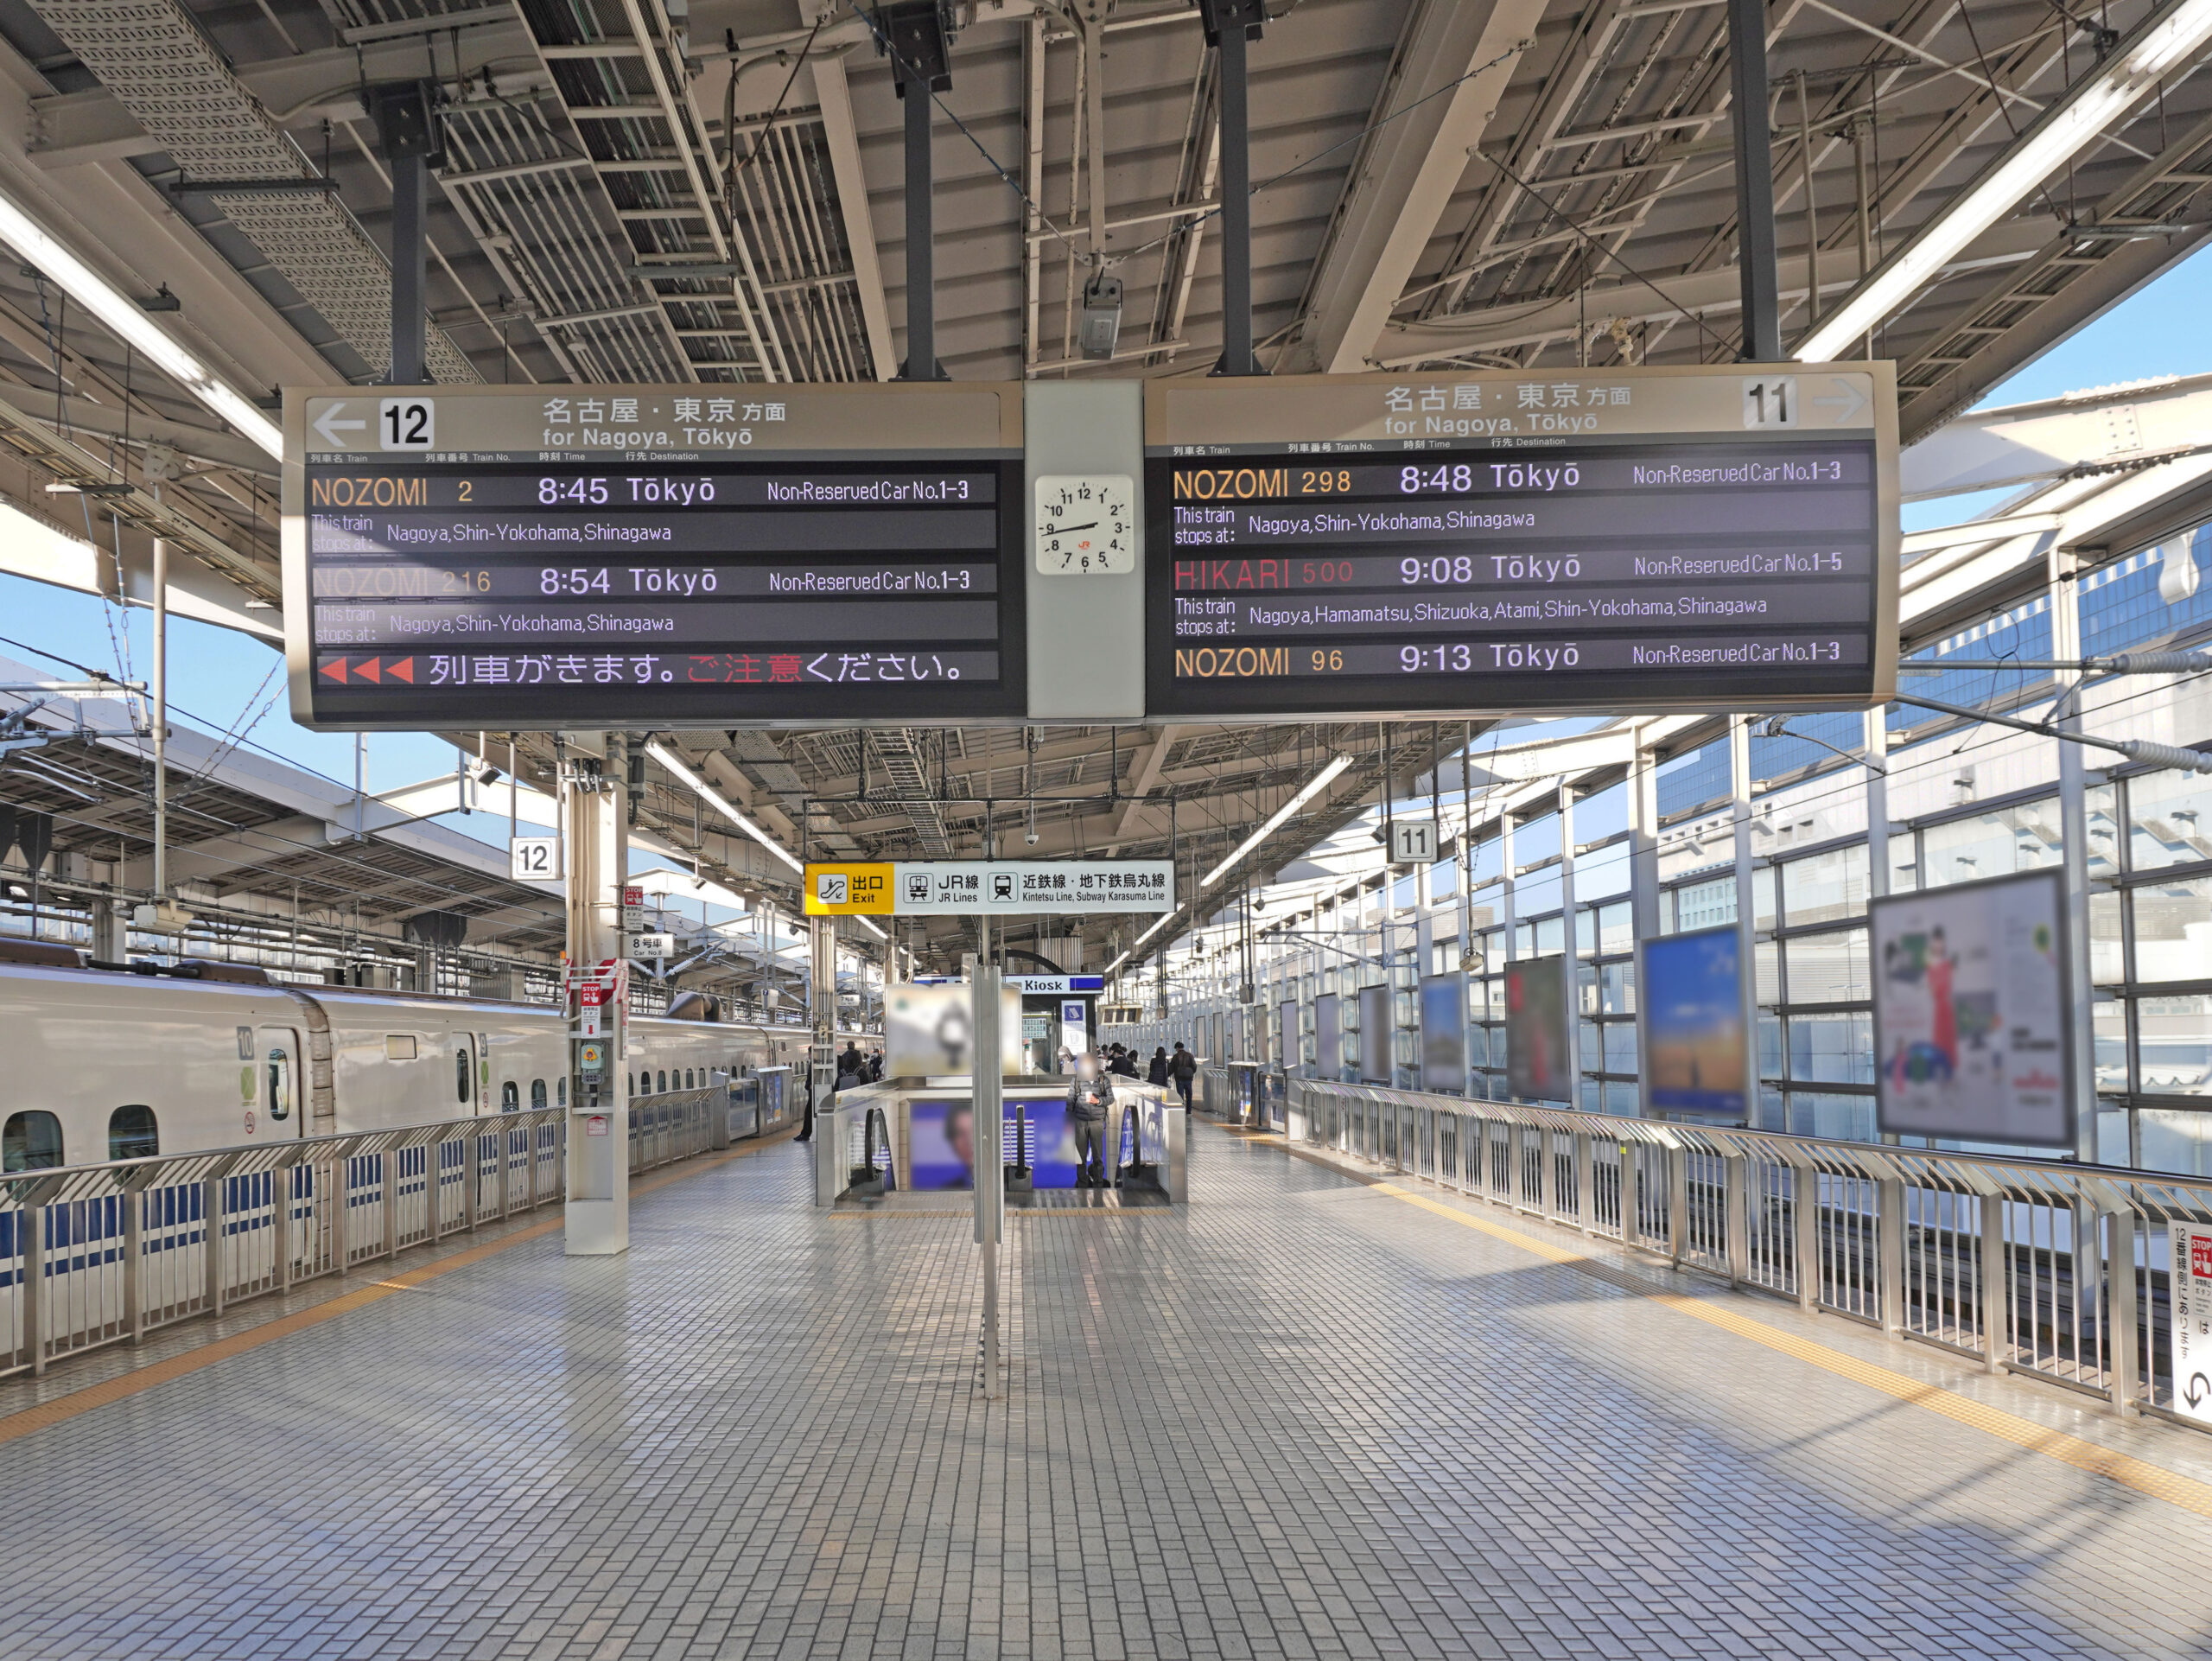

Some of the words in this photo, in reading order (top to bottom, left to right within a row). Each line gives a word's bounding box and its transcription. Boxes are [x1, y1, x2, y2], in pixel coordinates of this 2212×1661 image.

[1749, 383, 1788, 423] 11
[385, 404, 429, 444] 12
[1385, 417, 1416, 435] for
[1426, 415, 1520, 436] Nagoya,
[1527, 412, 1598, 434] Tōkyō
[543, 429, 575, 446] for
[583, 429, 675, 450] Nagoya,
[683, 428, 753, 449] Tōkyō
[1403, 439, 1426, 449] 時刻
[1427, 440, 1451, 449] Time
[1491, 437, 1513, 448] 行先
[1516, 436, 1566, 447] Destination
[1173, 445, 1205, 456] 列車名
[1209, 446, 1230, 455] Train
[1287, 442, 1332, 454] 列車番号
[1336, 443, 1357, 452] Train
[1359, 442, 1375, 451] No.
[310, 453, 343, 463] 列車名
[347, 454, 368, 462] Train
[425, 452, 467, 462] 列車番号
[472, 454, 493, 462] Train
[539, 452, 560, 461] 時刻
[626, 452, 646, 461] 行先
[650, 452, 698, 461] Destination
[1173, 468, 1289, 500] NOZOMI
[1301, 471, 1351, 493] 298
[1401, 465, 1471, 493] 8:48
[1491, 463, 1580, 491] Tōkyō
[1633, 463, 1747, 485] Non-Reserved
[1751, 463, 1780, 480] Car
[1783, 461, 1841, 481] No.1-3
[311, 477, 427, 506] NOZOMI
[458, 480, 473, 502] 2
[538, 478, 608, 504] 8:45
[627, 478, 715, 506] Tōkyō
[767, 480, 879, 501] Non-Reserved
[881, 480, 910, 500] Car
[912, 480, 969, 500] No.1-3
[1077, 488, 1090, 500] 12
[1061, 493, 1072, 504] 11
[1098, 493, 1104, 504] 1
[1050, 506, 1063, 517] 10
[1110, 505, 1118, 516] 2
[1173, 506, 1205, 524] This
[1205, 506, 1235, 524] train
[311, 513, 340, 531] This
[342, 515, 373, 531] train
[1115, 523, 1122, 533] 3
[1046, 524, 1054, 535] 9
[1175, 529, 1211, 545] stops
[1215, 528, 1236, 544] at:
[1052, 540, 1059, 550] 8
[1110, 539, 1117, 550] 4
[1065, 552, 1072, 563] 7
[1082, 557, 1089, 568] 6
[1099, 551, 1106, 563] 5
[1174, 559, 1289, 590] HIKARI
[1302, 562, 1353, 583] 500
[1401, 557, 1472, 584] 9:08
[1491, 555, 1581, 582] Tōkyō
[1635, 556, 1749, 576] Non-Reserved
[1751, 555, 1782, 573] Car
[1784, 552, 1842, 572] No.1-5
[314, 568, 429, 597] NOZOMI
[442, 570, 491, 593] 216
[540, 568, 611, 595] 8:54
[629, 568, 718, 596] Tōkyō
[769, 571, 880, 591] Non-Reserved
[882, 571, 912, 590] Car
[914, 570, 970, 590] No.1-3
[1174, 598, 1205, 615] This
[1206, 598, 1236, 614] train
[315, 605, 344, 623] This
[346, 607, 375, 623] train
[1175, 620, 1212, 636] stops
[1216, 620, 1236, 633] at:
[315, 626, 353, 644] stops
[1175, 647, 1289, 678] NOZOMI
[1312, 650, 1344, 671] 96
[1401, 645, 1471, 672] 9:13
[1490, 643, 1580, 671] Tōkyō
[1633, 646, 1747, 665] Non-Reserved
[1750, 644, 1780, 662] Car
[1783, 641, 1840, 661] No.1-3
[1402, 829, 1426, 854] 11
[519, 845, 548, 871] 12
[852, 875, 884, 891] 出口
[938, 875, 980, 890] JR線
[853, 893, 875, 904] Exit
[938, 893, 951, 904] JR
[953, 892, 978, 903] Lines
[1023, 892, 1056, 902] Kintetsu
[1058, 892, 1075, 904] Line,
[1077, 891, 1107, 904] Subway
[1108, 891, 1147, 901] Karasuma
[1148, 891, 1165, 901] Line
[1025, 979, 1063, 990] Kiosk
[238, 1031, 252, 1057] 10
[2191, 1239, 2212, 1251] STOP
